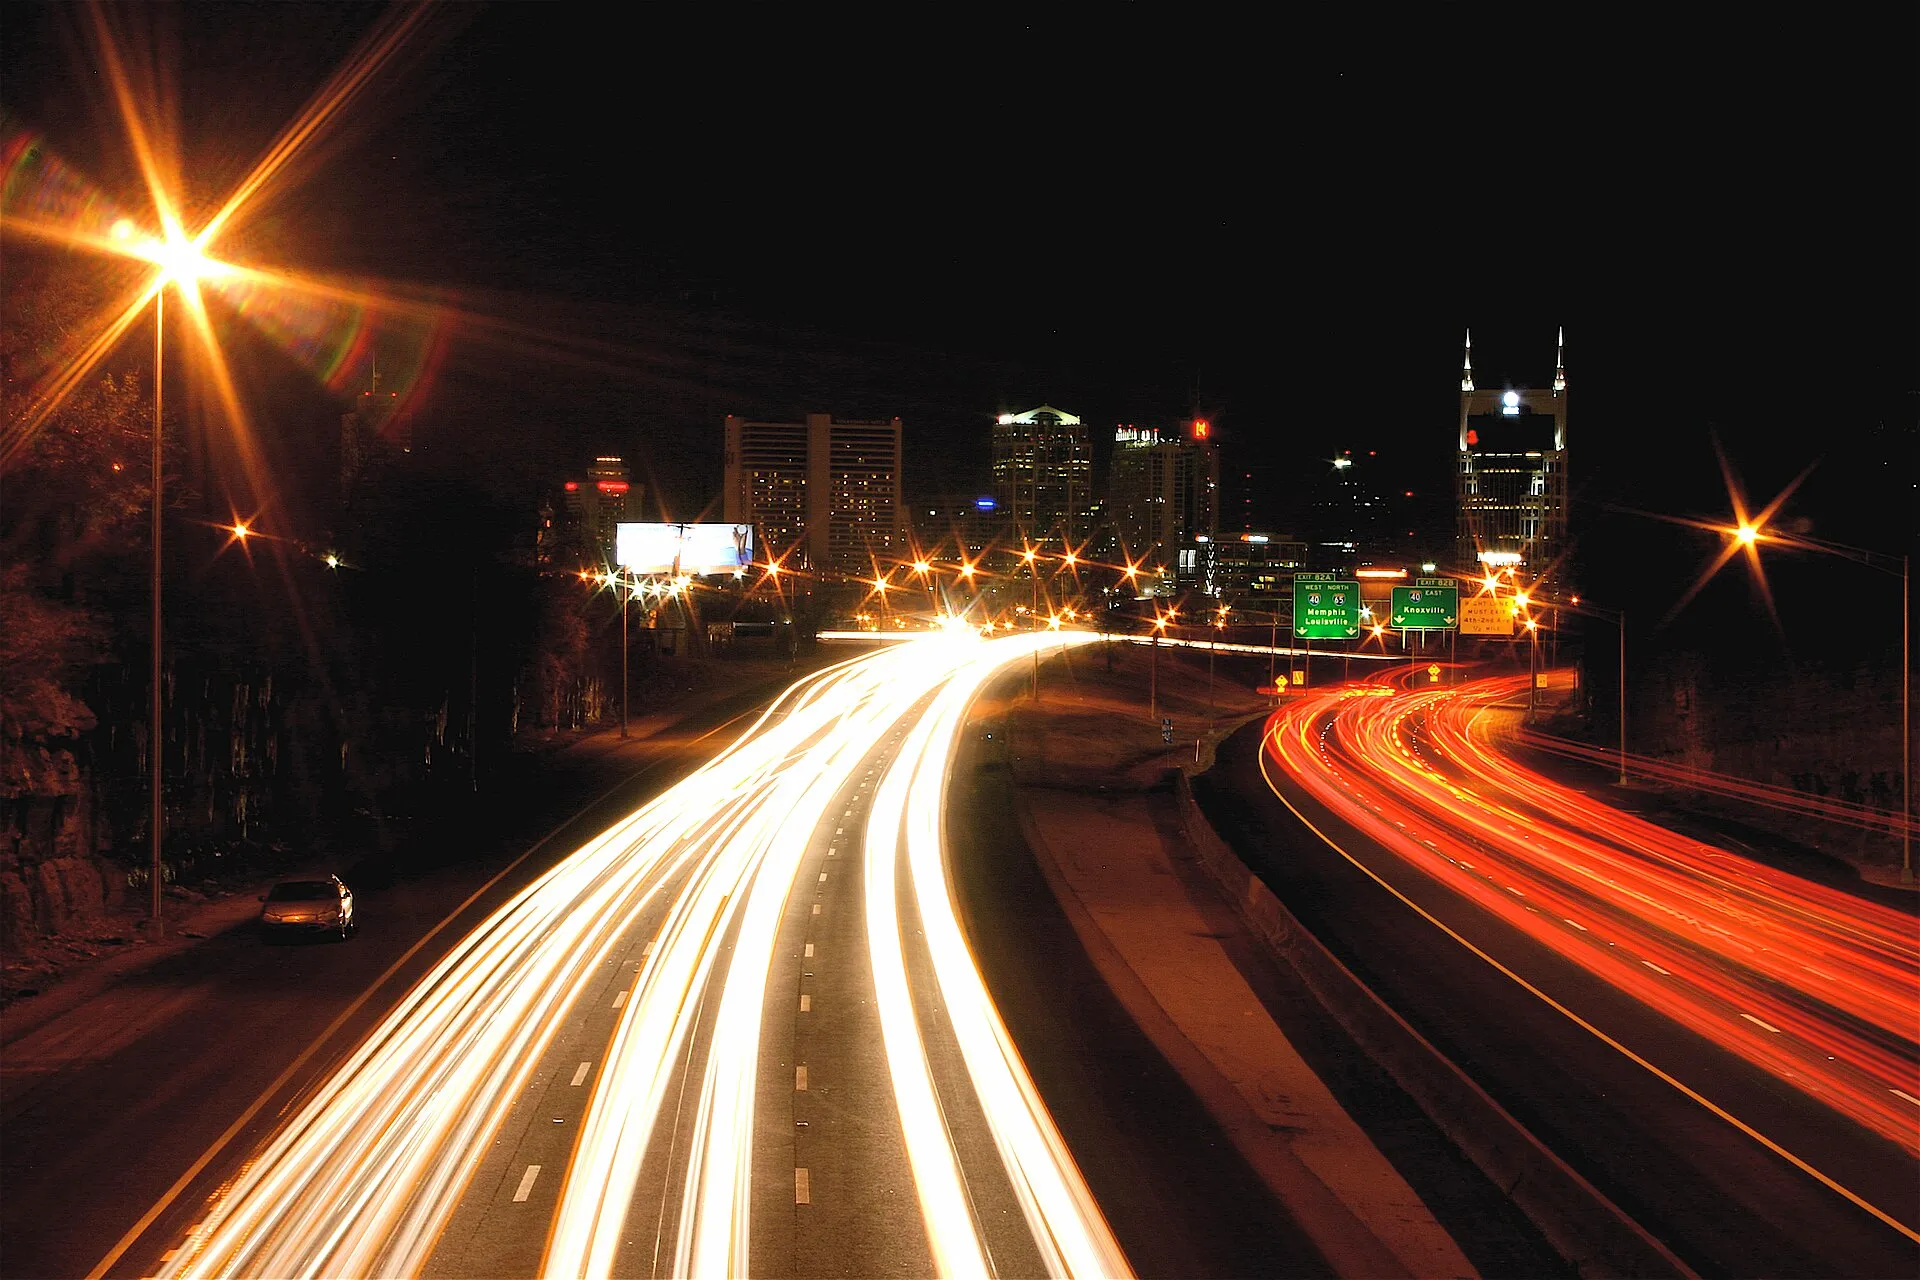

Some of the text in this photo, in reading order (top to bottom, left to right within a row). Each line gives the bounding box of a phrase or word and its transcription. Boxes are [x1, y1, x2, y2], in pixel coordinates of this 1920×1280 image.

[1410, 592, 1421, 600] 40
[1307, 608, 1346, 617] Memphis
[1403, 606, 1445, 614] Knoxville
